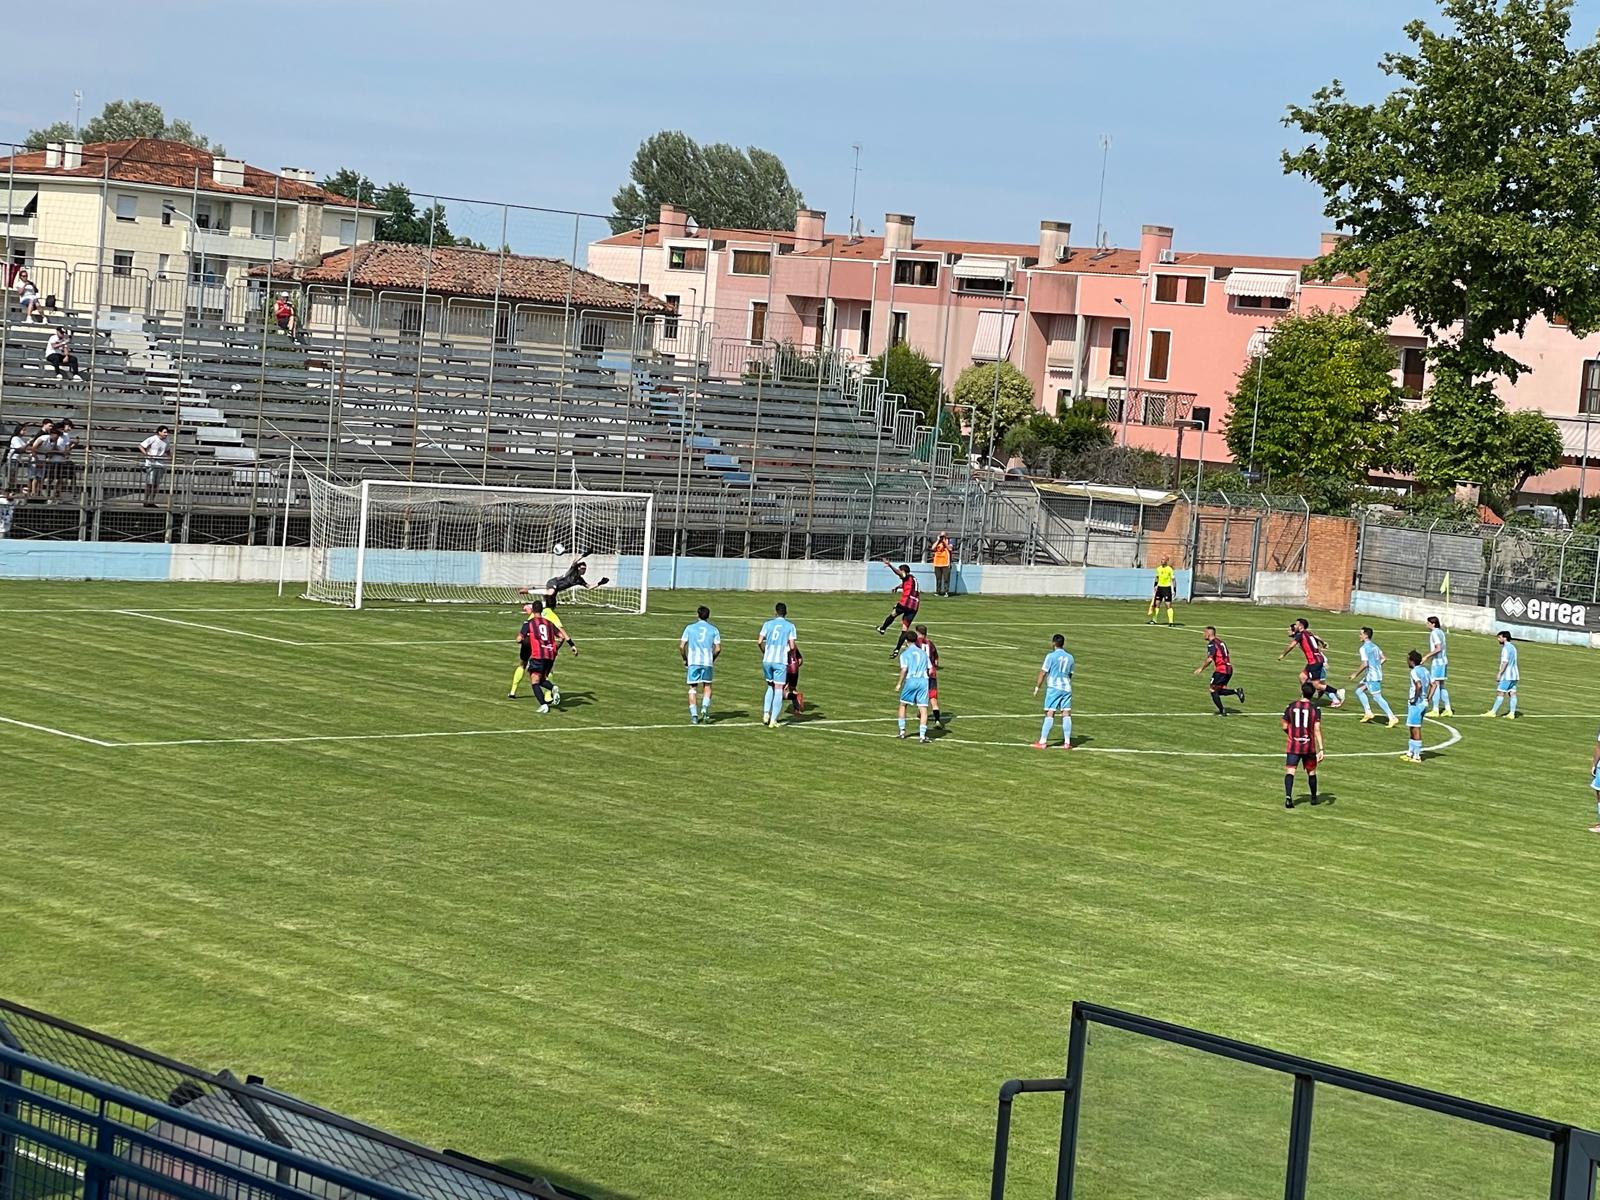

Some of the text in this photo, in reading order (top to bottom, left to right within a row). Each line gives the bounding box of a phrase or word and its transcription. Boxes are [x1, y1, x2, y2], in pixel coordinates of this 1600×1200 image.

[539, 623, 548, 641] 9
[698, 626, 707, 642] 3
[772, 624, 782, 640] 6
[1058, 655, 1069, 673] 11
[1292, 708, 1309, 728] 11
